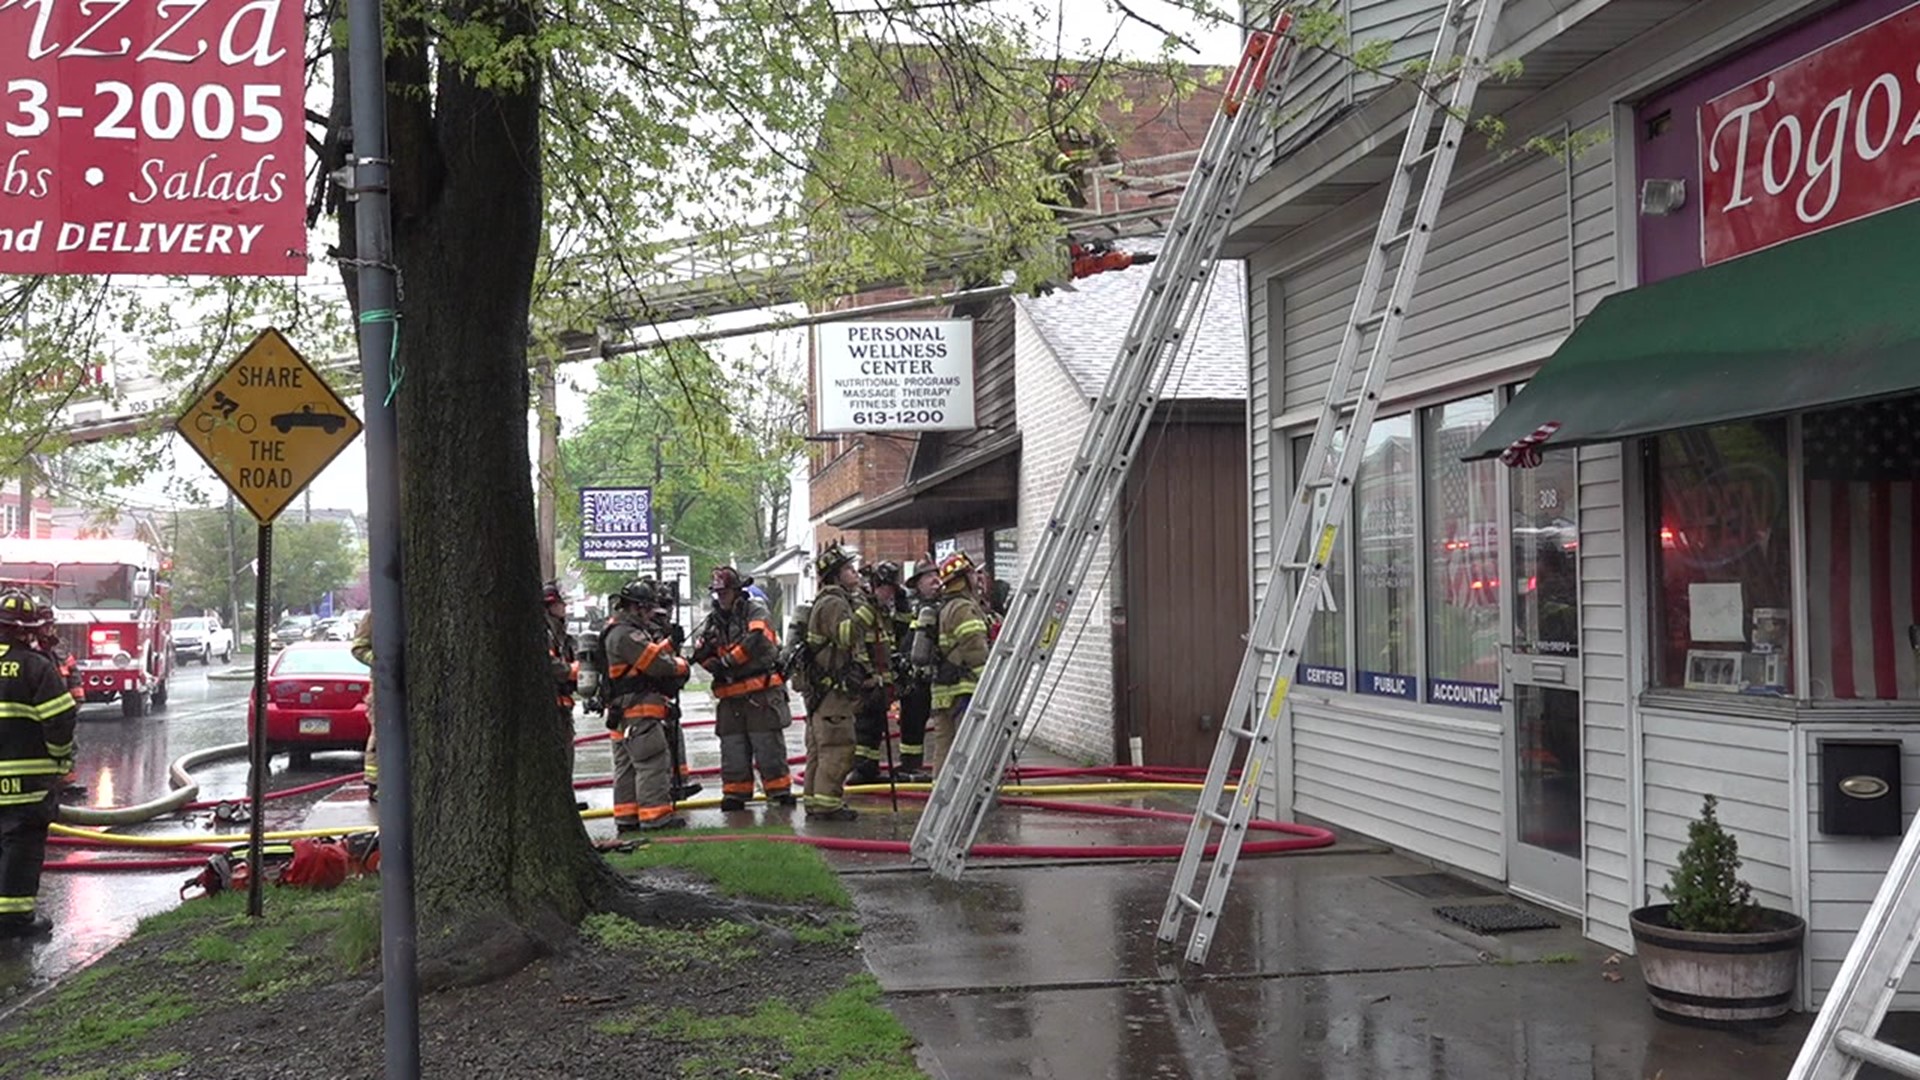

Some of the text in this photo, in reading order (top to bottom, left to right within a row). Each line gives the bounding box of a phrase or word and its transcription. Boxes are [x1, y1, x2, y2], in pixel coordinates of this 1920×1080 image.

[0, 0, 287, 67] izza
[5, 79, 284, 143] 3-2005
[128, 153, 287, 204] Salads
[56, 222, 264, 254] DELIVERY
[848, 327, 946, 342] PERSONAL
[847, 344, 948, 359] WELLNESS
[238, 365, 303, 388] SHARE
[861, 360, 935, 376] CENTER
[834, 376, 961, 388] NUTRITIONAL PROGRAMS
[843, 387, 952, 398] MASSAGE THERAPY
[850, 399, 946, 409] FITNESS CENTER
[853, 410, 944, 425] 613-1200
[250, 440, 286, 461] THE
[239, 467, 293, 489] ROAD
[594, 493, 648, 512] WEBB
[1539, 488, 1558, 509] 308
[595, 522, 648, 533] CENTER
[1306, 667, 1346, 686] CERTIFIED
[1373, 676, 1407, 695] PUBLIC
